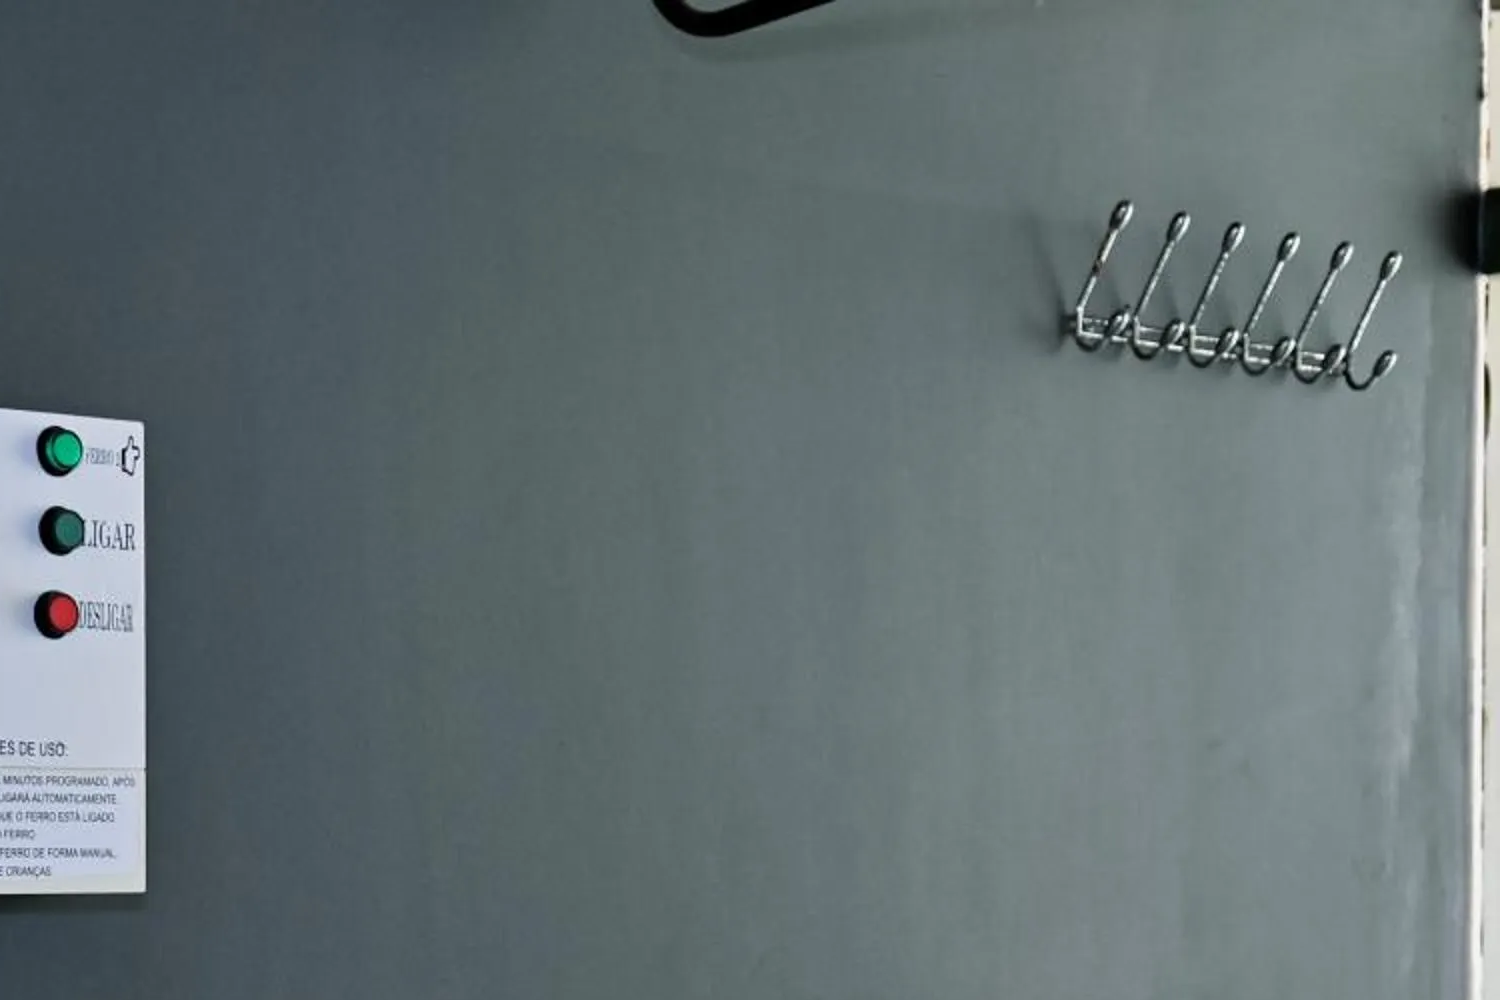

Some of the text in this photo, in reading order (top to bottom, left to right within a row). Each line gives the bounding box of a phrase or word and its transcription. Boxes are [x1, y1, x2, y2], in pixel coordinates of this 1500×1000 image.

[81, 519, 136, 551] LIGAR
[78, 600, 134, 633] DESLIGAR
[18, 741, 36, 757] DE
[3, 775, 44, 786] MINUTOS
[15, 811, 23, 822] O
[25, 811, 57, 822] FERRO
[0, 847, 31, 859] FERRO
[32, 847, 45, 859] DE
[47, 847, 79, 859] FORMA
